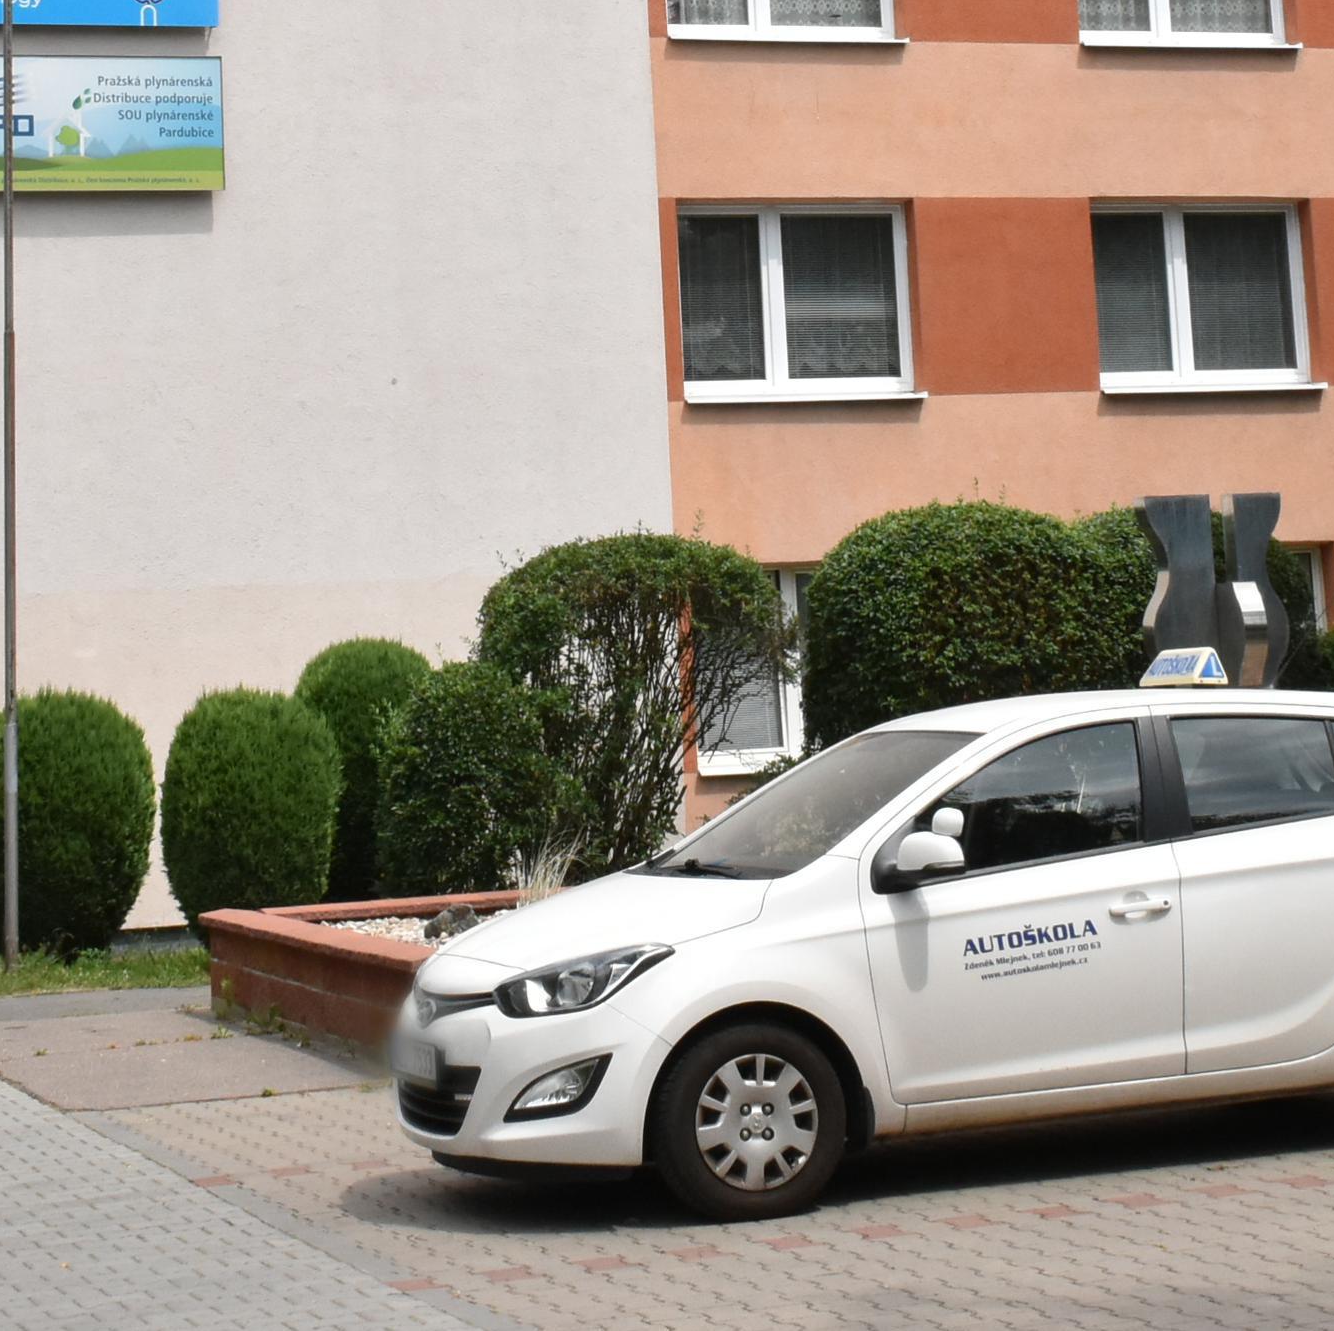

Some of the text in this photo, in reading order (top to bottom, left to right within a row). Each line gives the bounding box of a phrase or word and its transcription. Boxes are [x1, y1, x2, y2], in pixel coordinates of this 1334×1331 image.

[97, 75, 213, 89] Pražská plynárenská
[93, 92, 213, 106] Distribuce podporuje
[117, 109, 214, 123] SOU plynárenské
[159, 126, 214, 138] Pardubice
[963, 919, 1098, 957] AUTOŠKOLA
[1066, 945, 1076, 954] 77
[1077, 943, 1089, 952] 00
